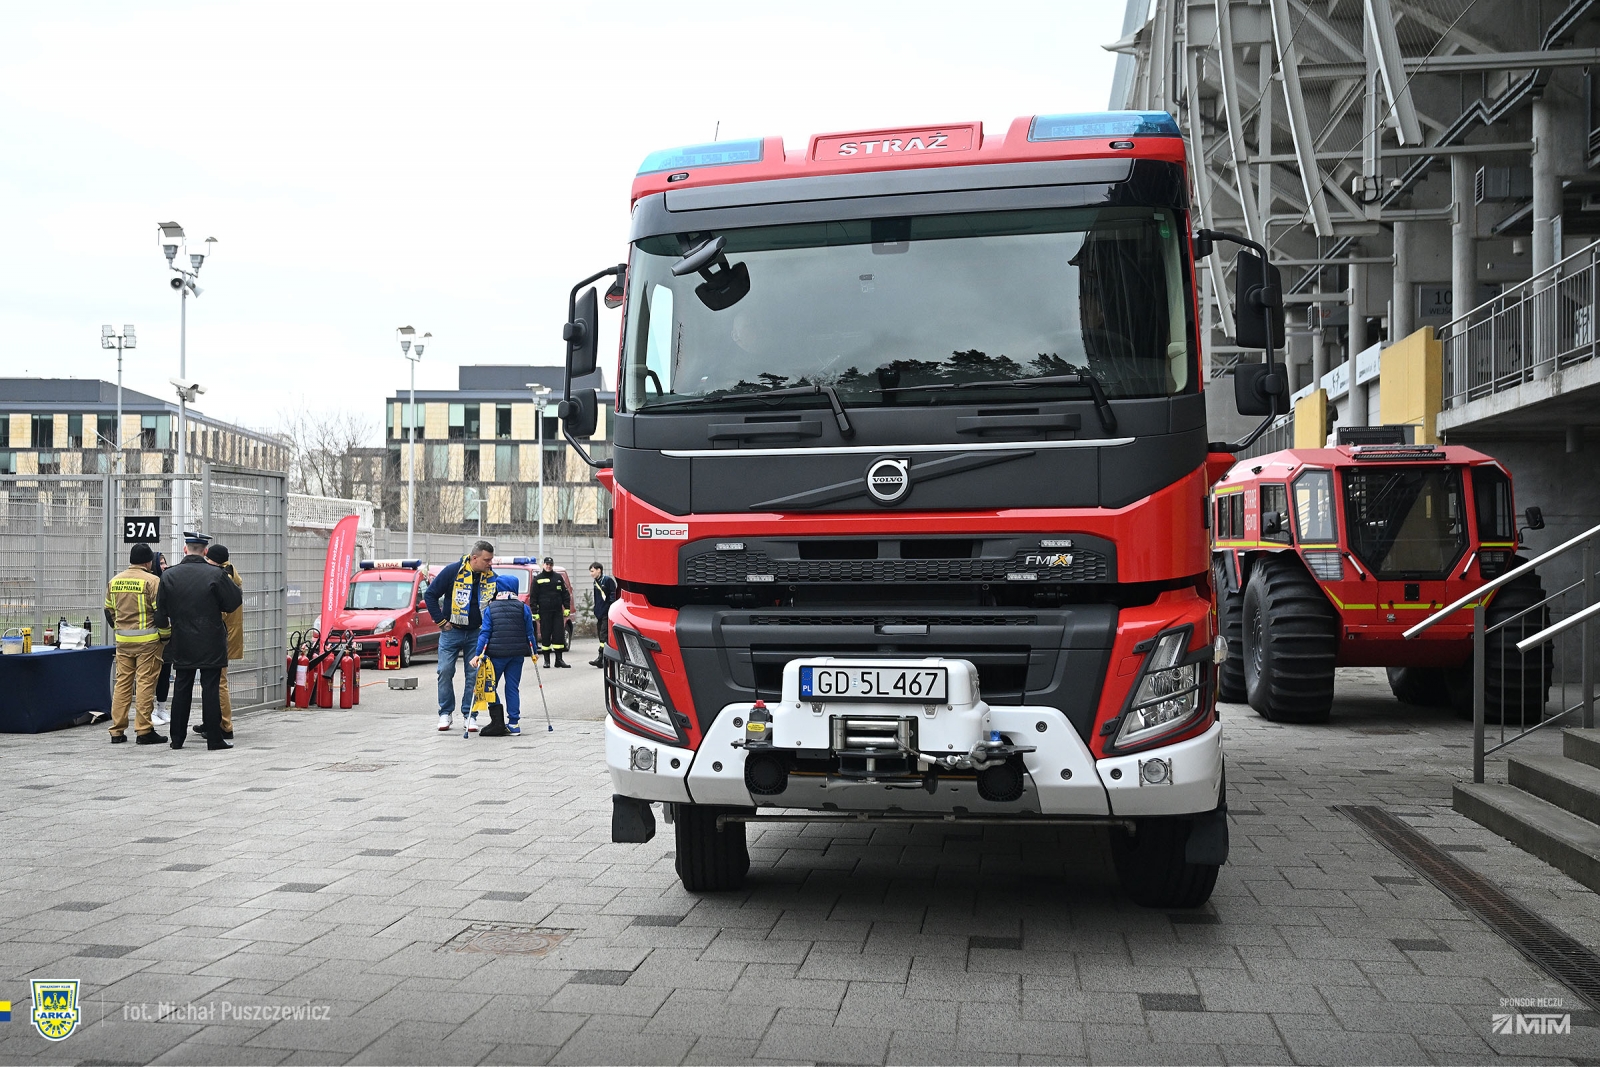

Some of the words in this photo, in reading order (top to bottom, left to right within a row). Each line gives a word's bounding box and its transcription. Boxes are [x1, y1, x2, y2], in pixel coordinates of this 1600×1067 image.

[838, 132, 949, 156] STRAŻ
[126, 522, 157, 538] 37A
[655, 528, 687, 536] bocar
[818, 670, 849, 694] GD
[860, 671, 939, 696] 5L467
